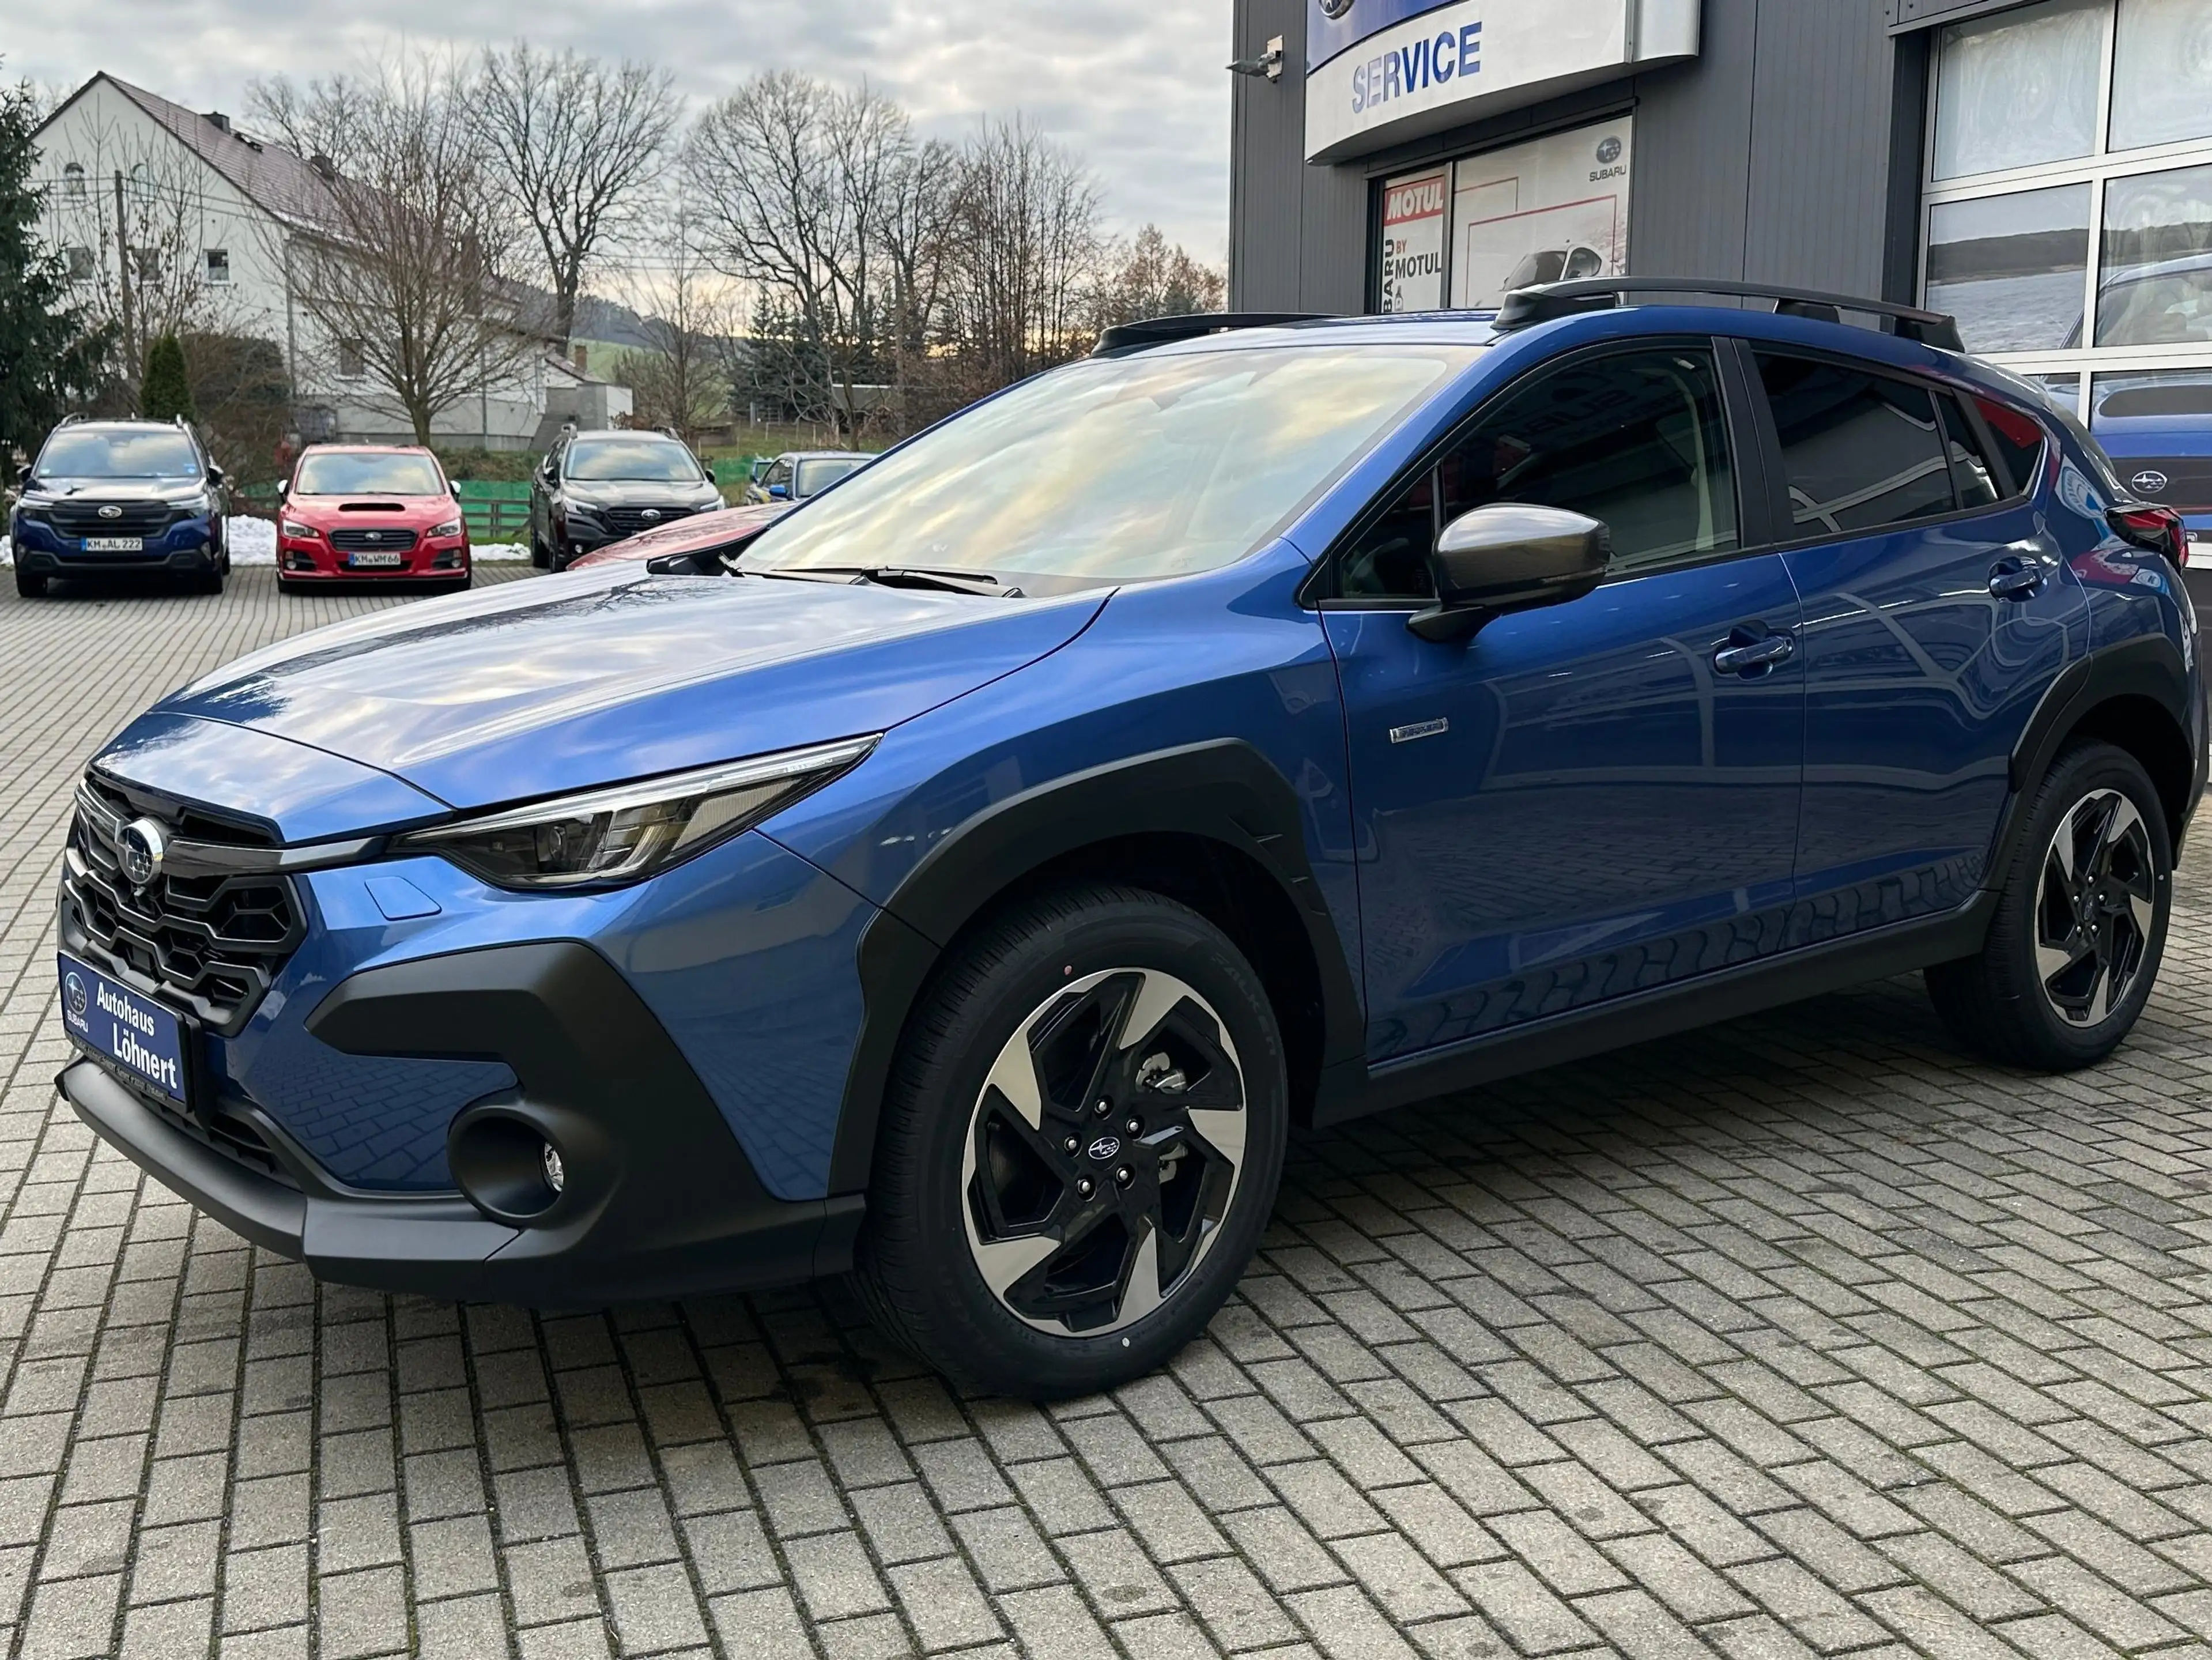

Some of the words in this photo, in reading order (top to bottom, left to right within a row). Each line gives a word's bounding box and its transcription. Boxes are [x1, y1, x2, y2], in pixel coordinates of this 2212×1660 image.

[1352, 21, 1482, 114] SERVICE
[1589, 164, 1627, 182] SUBARU
[1387, 182, 1443, 221] MOTUL
[1396, 239, 1407, 255] BY
[1395, 251, 1442, 280] MOTUL
[67, 1009, 89, 1033] SUBARU
[96, 982, 155, 1037] Autohaus
[113, 1023, 178, 1089] Löhnert
